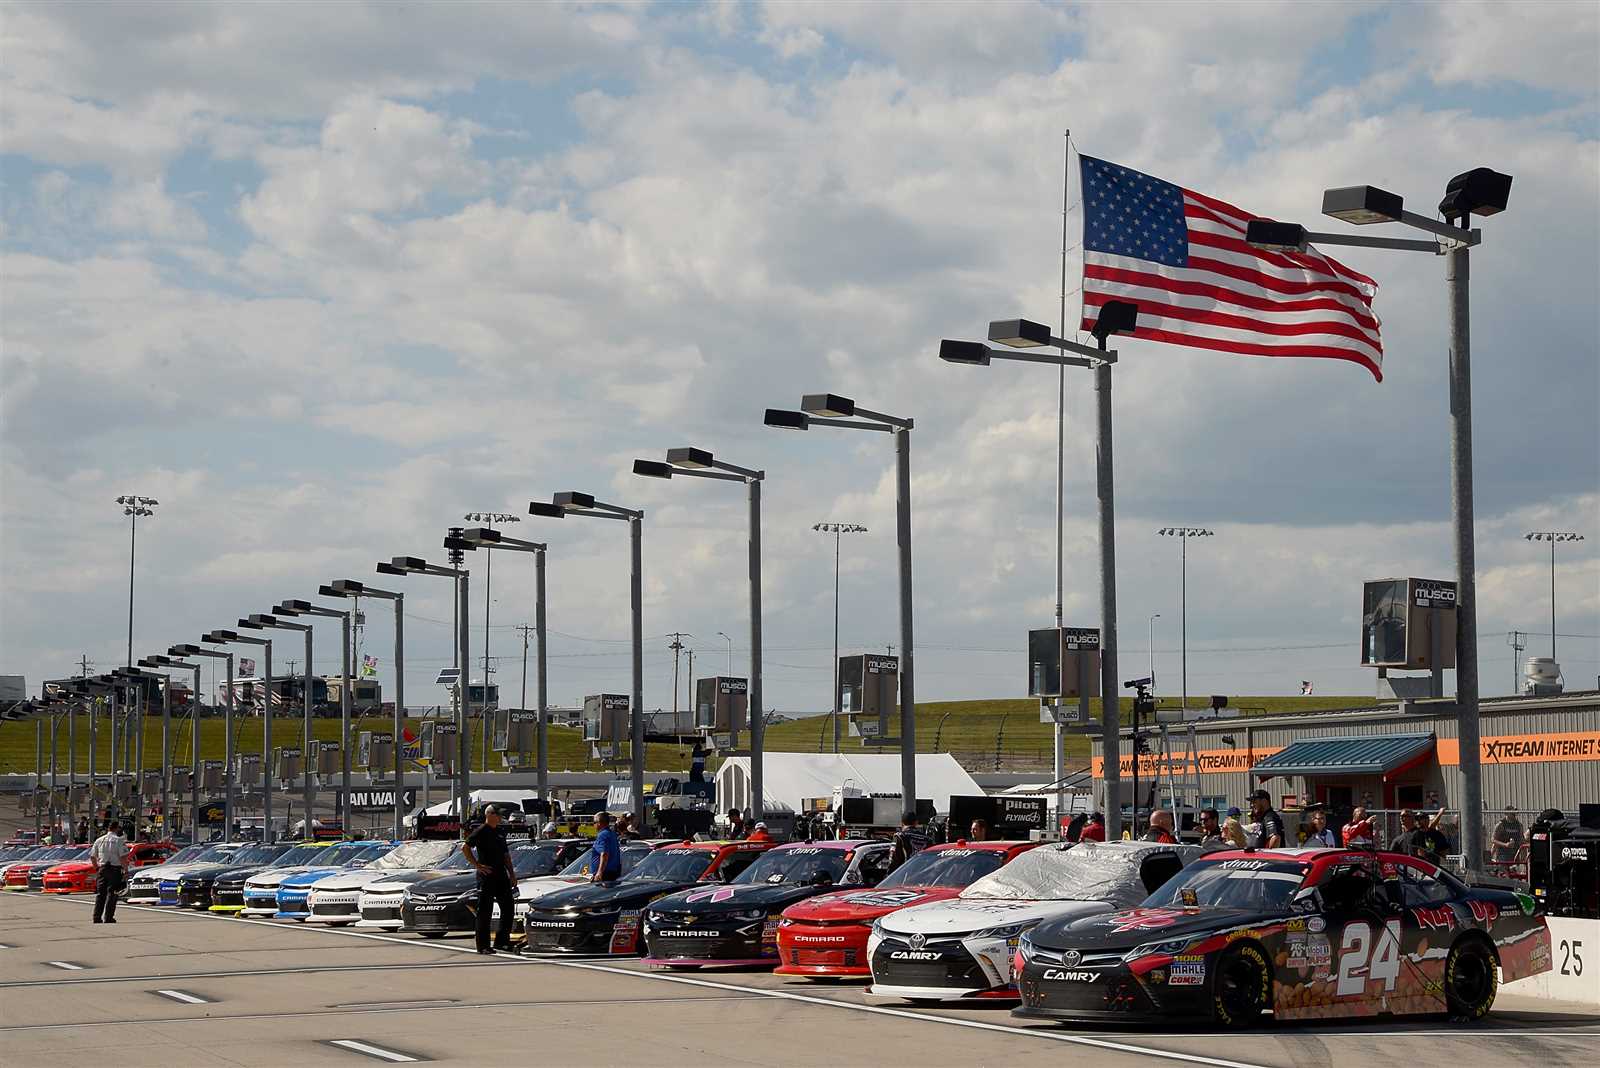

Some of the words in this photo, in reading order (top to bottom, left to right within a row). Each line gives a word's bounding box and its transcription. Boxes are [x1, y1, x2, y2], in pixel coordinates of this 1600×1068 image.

[1486, 740, 1544, 763] XTREAM
[1547, 739, 1596, 756] INTERNET
[341, 792, 367, 806] AN
[371, 792, 410, 806] WAK
[1005, 814, 1030, 822] FLYING
[890, 951, 943, 961] CAMRY
[1336, 919, 1401, 996] 24
[1560, 939, 1583, 976] 25
[1043, 969, 1101, 983] CAMRY
[1171, 965, 1205, 975] MAHLE
